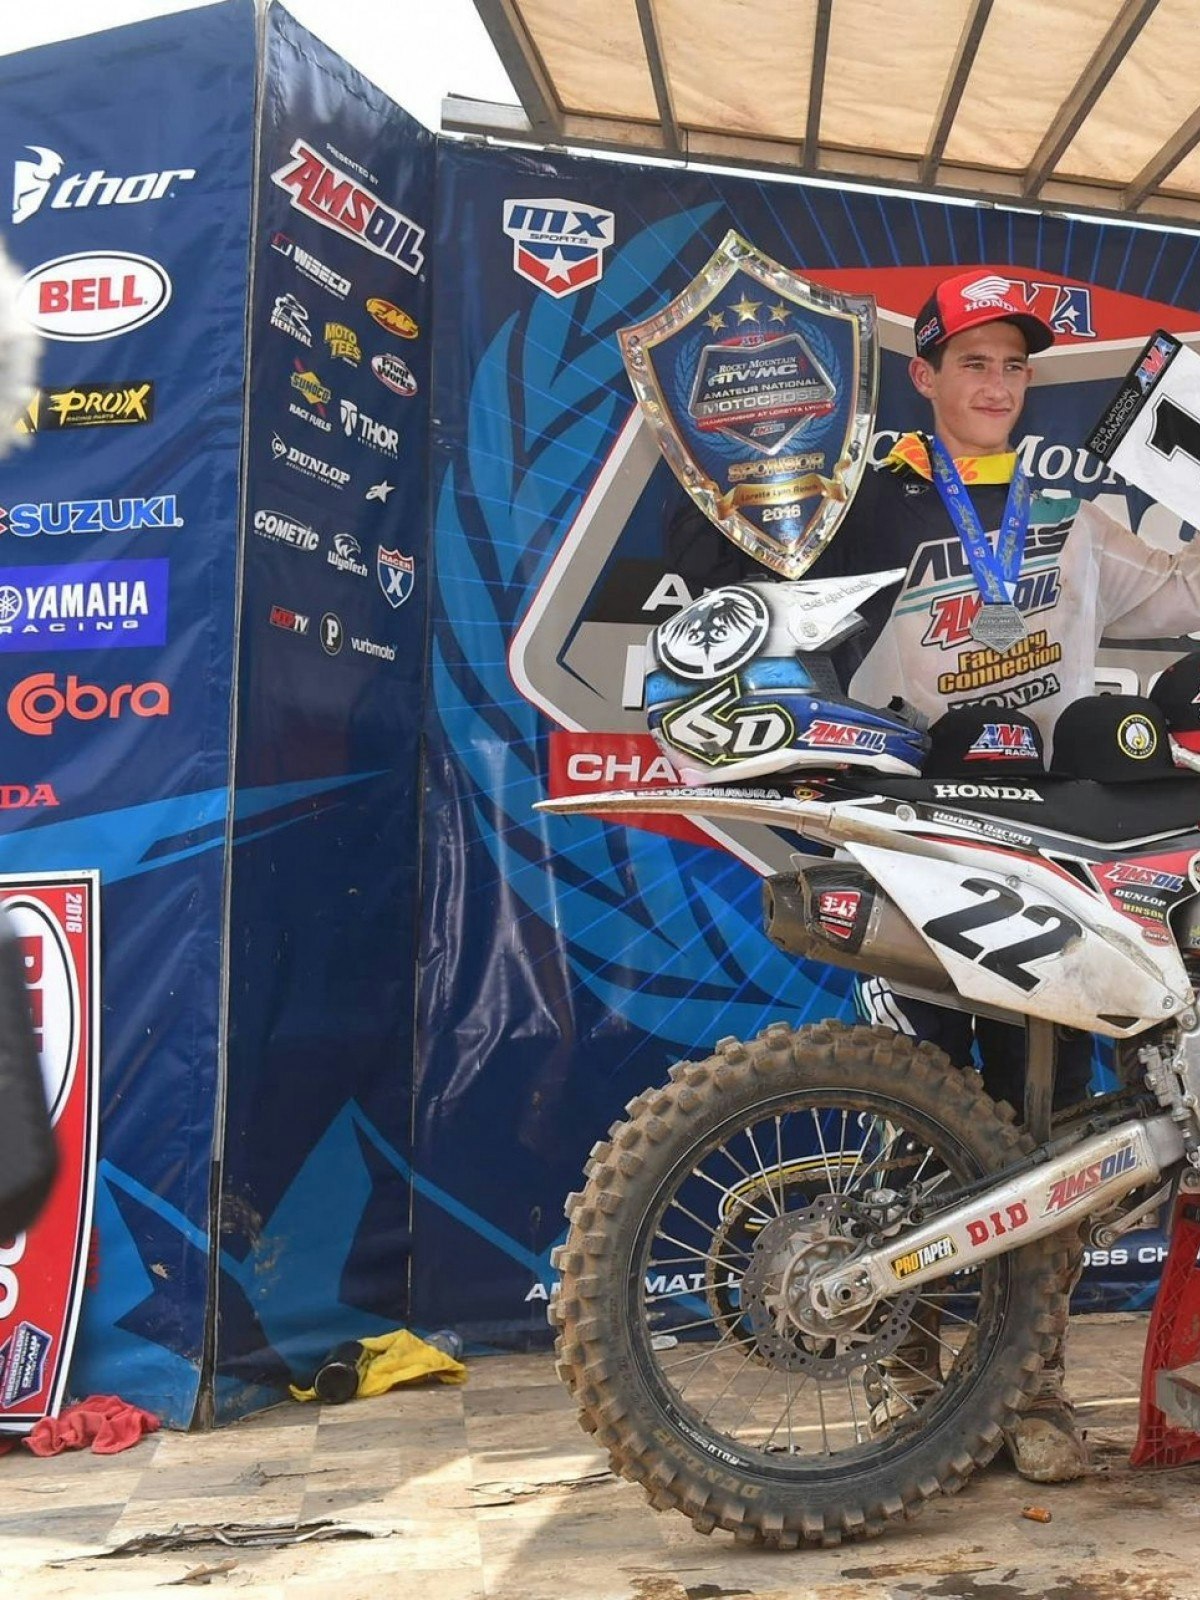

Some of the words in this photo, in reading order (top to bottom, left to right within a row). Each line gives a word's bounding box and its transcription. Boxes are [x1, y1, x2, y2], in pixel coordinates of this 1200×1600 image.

[326, 142, 369, 178] PRESENTED
[369, 174, 379, 186] BY
[51, 169, 196, 209] thor
[276, 143, 423, 273] AMSOIL
[529, 232, 589, 244] SPORTS
[39, 274, 145, 314] BELL
[366, 298, 419, 335] FMF
[270, 316, 313, 348] RENTHAL
[325, 322, 358, 343] MOTO
[331, 338, 362, 362] TEES
[748, 356, 797, 369] MOUNTAIN
[377, 365, 414, 391] Works
[381, 357, 409, 379] Pivot
[291, 375, 331, 402] SUNOCO
[702, 389, 822, 415] MOTOCROSS
[703, 385, 759, 400] AMATEUR
[761, 378, 819, 391] NATIONAL
[288, 403, 309, 420] RACE
[309, 415, 332, 433] FUELS
[1095, 389, 1141, 454] CHAMPION
[359, 413, 399, 454] THOR
[286, 446, 351, 485] DUNLOP
[728, 453, 826, 483] SPONSOR
[9, 494, 177, 537] SUZUKI
[762, 503, 802, 522] 2016
[254, 511, 320, 551] COMETIC
[327, 551, 368, 577] WyoTech
[381, 553, 411, 570] RACER
[386, 568, 404, 598] X
[25, 581, 149, 619] YAMAHA
[326, 618, 339, 647] P
[351, 637, 396, 661] vurbmoto
[959, 631, 1047, 671] Facory
[938, 643, 1062, 694] Connection
[6, 672, 170, 735] Cobra
[672, 686, 787, 754] 6D
[802, 720, 886, 752] AMSOIL
[971, 723, 1037, 750] AMA
[1004, 749, 1039, 759] RACING
[933, 783, 1045, 802] HONDA
[933, 810, 982, 829] Honda
[982, 823, 1034, 846] Racing
[1105, 863, 1184, 891] AMSOIL
[1113, 888, 1167, 907] DUNLOP
[1121, 902, 1165, 921] HINSON
[65, 892, 83, 934] 2016
[921, 877, 1084, 993] 22
[1043, 1146, 1138, 1214] AMSOIL
[895, 1237, 955, 1274] PROTAPER
